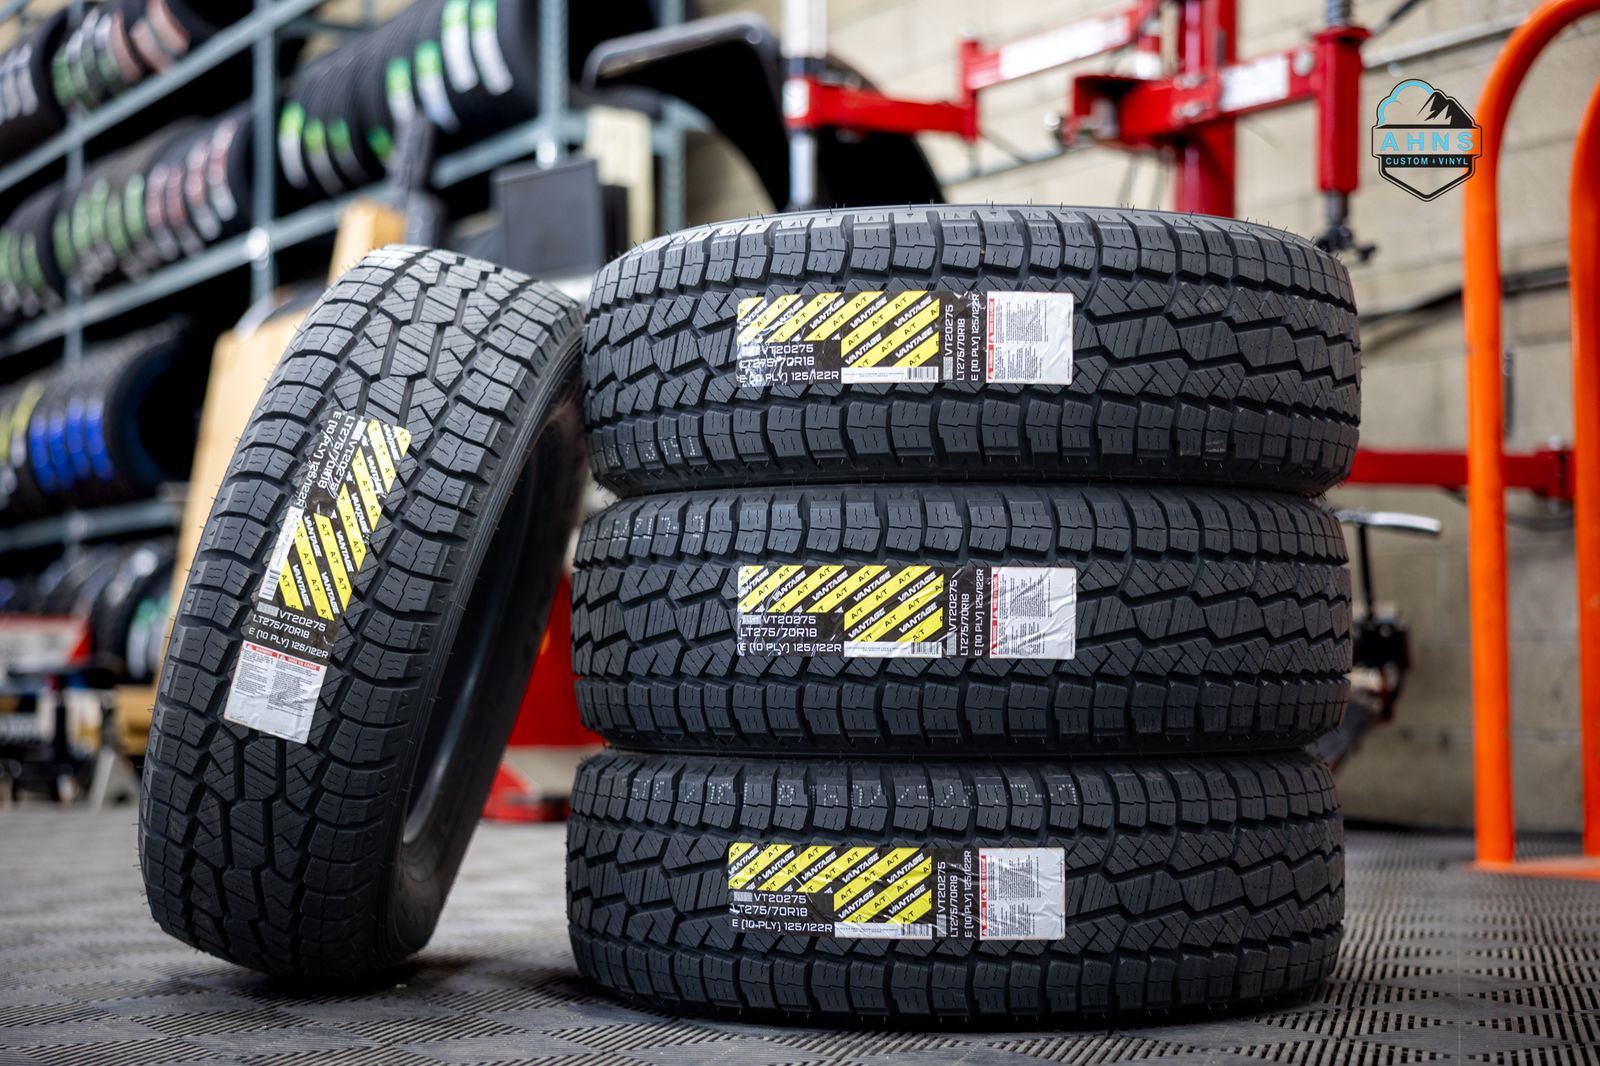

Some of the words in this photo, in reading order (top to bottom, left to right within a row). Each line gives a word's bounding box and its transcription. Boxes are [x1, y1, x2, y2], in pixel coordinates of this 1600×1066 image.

[850, 296, 888, 329] VANTAGE
[844, 332, 882, 365] VANTAGE
[894, 295, 932, 327] VANTAGE
[895, 326, 933, 359] VANTAGE
[945, 304, 954, 356] VT20275
[762, 344, 814, 354] VT20275
[956, 318, 966, 381] LT275/70R18
[971, 373, 979, 381] E
[304, 515, 322, 557] VANTAGE
[321, 571, 340, 614] VANTAGE
[336, 530, 354, 572] VANTAGE
[292, 564, 311, 607] VANTAGE
[772, 570, 806, 601] VANTAGE
[812, 570, 848, 601] VANTAGE
[853, 571, 891, 602] VANTAGE
[975, 569, 984, 609] 125/122R
[763, 615, 816, 624] VT20275
[848, 607, 886, 638] VANTAGE
[898, 571, 936, 602] VANTAGE
[899, 602, 937, 633] VANTAGE
[949, 580, 958, 631] VT20275
[253, 614, 310, 639] LT275/70R18
[280, 610, 327, 632] VT20275
[740, 628, 817, 637] LT275/70R18
[960, 593, 970, 656] LT275/70R18
[249, 627, 255, 635] E
[291, 641, 329, 659] 125/122R
[793, 643, 842, 652] 125/122R
[728, 846, 759, 875] VANTAGE
[762, 850, 795, 879] VANTAGE
[801, 851, 837, 881] VANTAGE
[842, 852, 880, 883] VANTAGE
[963, 850, 972, 890] 125/122R
[754, 893, 806, 904] VT20275
[838, 889, 875, 919] VANTAGE
[887, 853, 925, 884] VANTAGE
[888, 884, 926, 915] VANTAGE
[938, 861, 946, 913] VT20275
[950, 875, 958, 938] LT275/70R18
[732, 919, 738, 927] E
[784, 923, 833, 932] 125/122R
